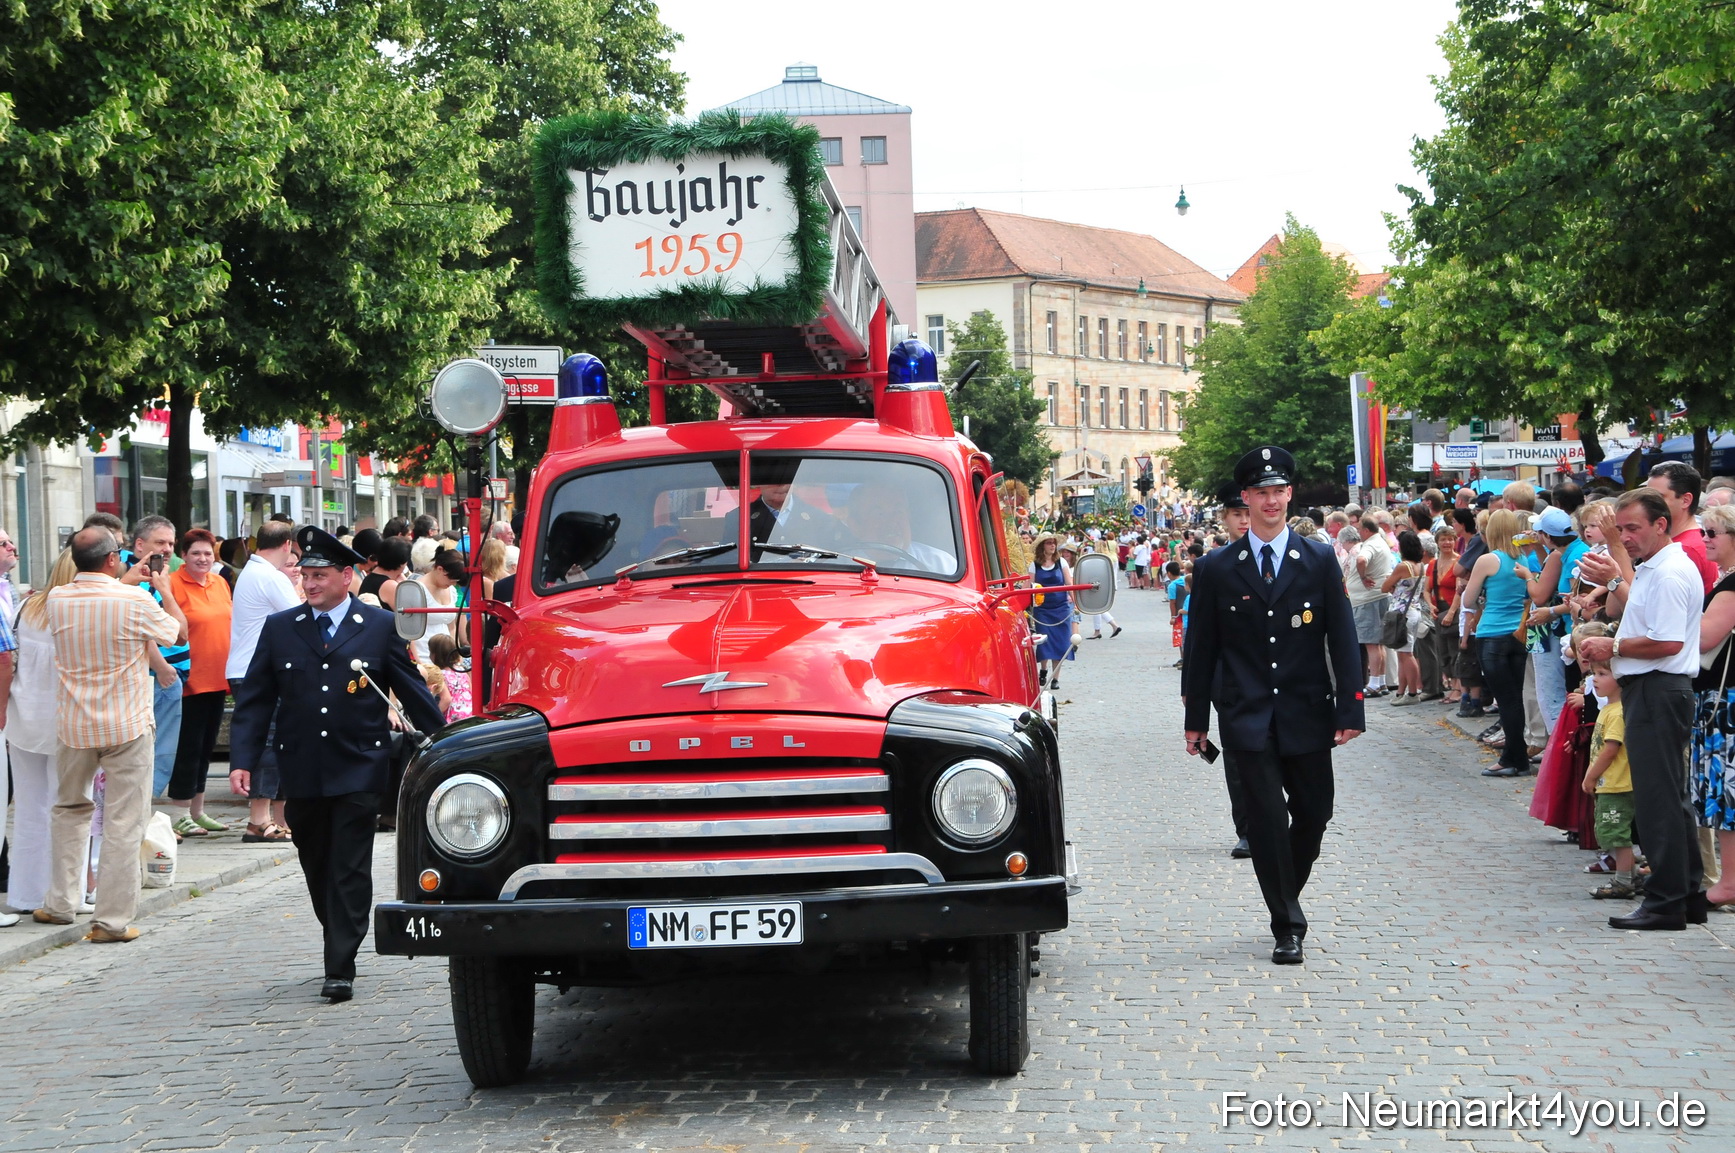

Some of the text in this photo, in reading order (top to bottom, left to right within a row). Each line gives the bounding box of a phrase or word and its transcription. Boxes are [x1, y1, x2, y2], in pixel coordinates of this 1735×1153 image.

[585, 161, 765, 229] Baujahr
[634, 232, 744, 278] 1959
[1537, 434, 1556, 442] optik
[1507, 447, 1585, 460] THUMANN BA
[1349, 466, 1356, 483] P
[629, 735, 806, 752] OPEL
[649, 908, 796, 942] NM FF 59
[634, 931, 642, 941] D
